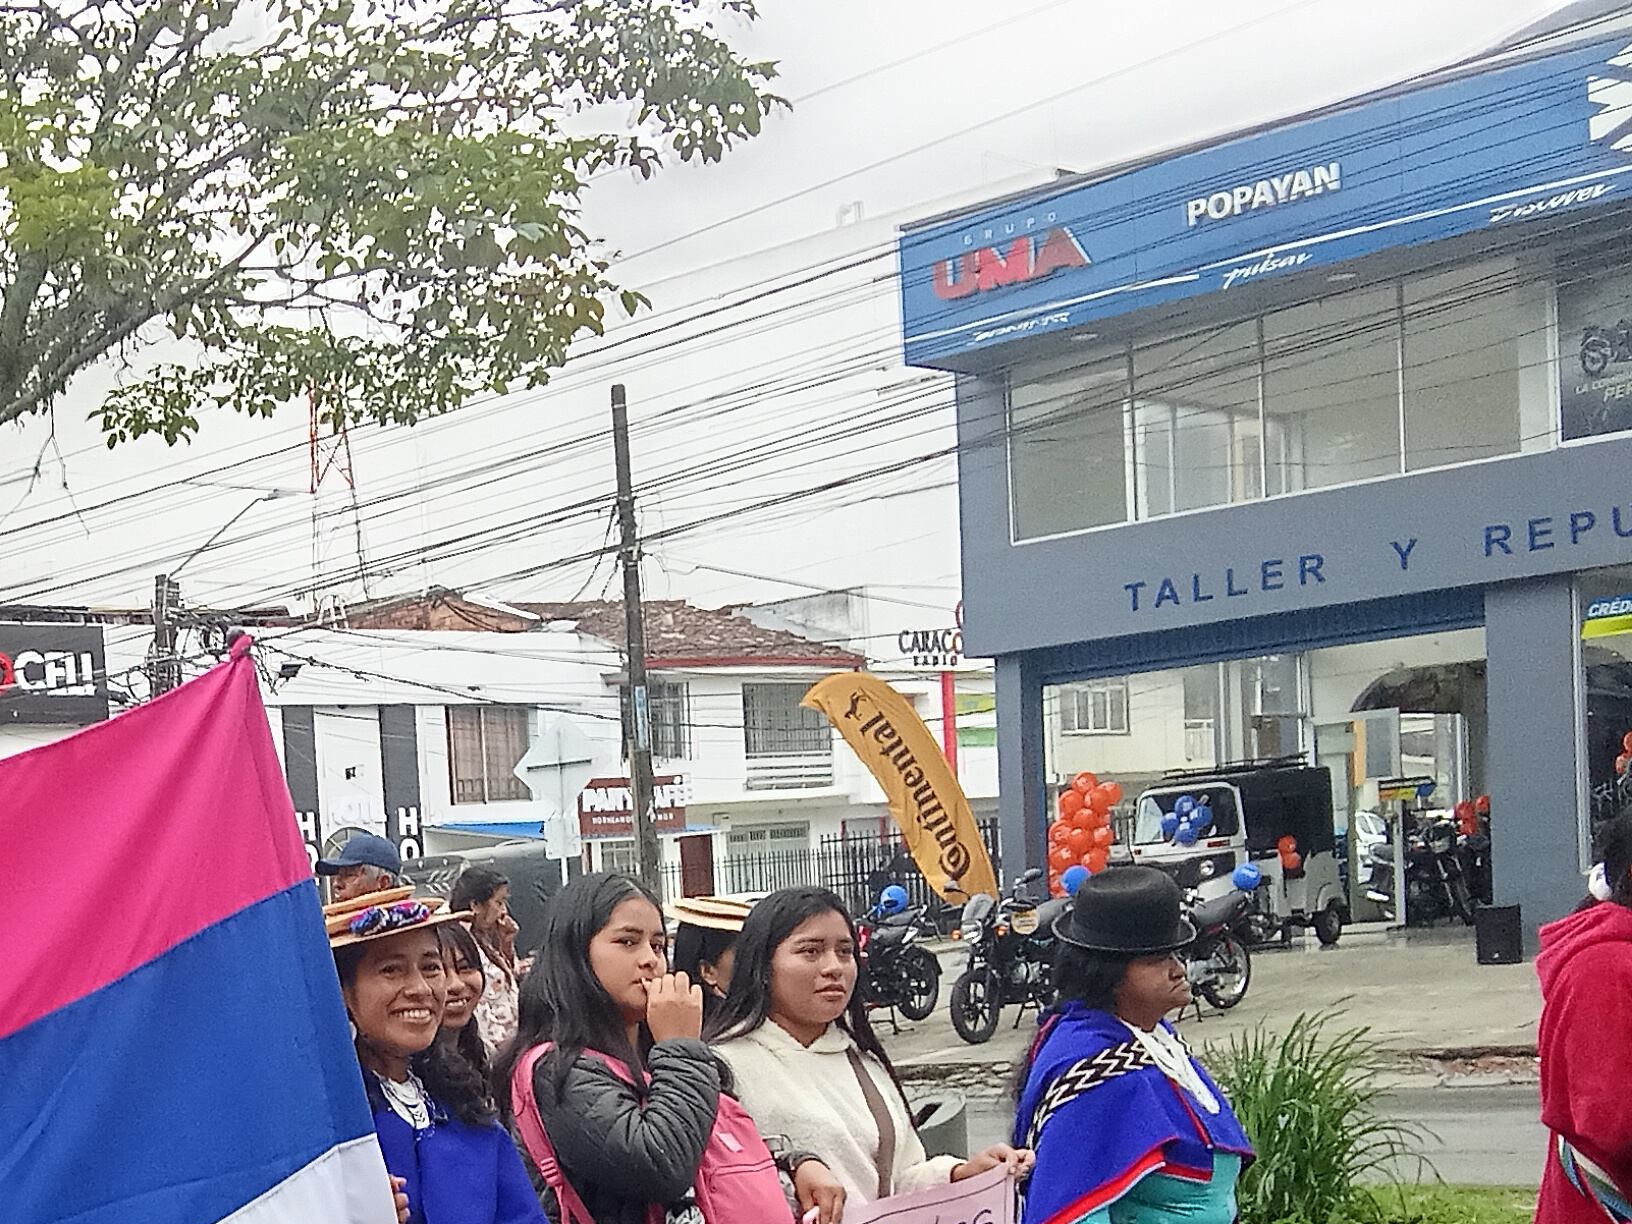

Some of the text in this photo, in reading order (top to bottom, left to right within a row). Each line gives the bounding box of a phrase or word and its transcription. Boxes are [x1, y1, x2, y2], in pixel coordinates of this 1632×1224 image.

[964, 212, 1057, 245] GRUPO
[1187, 162, 1342, 227] POPAYAN
[932, 226, 1092, 301] UMA
[1124, 553, 1326, 612] TALLER
[1390, 538, 1418, 570] Y
[859, 711, 971, 881] Continental
